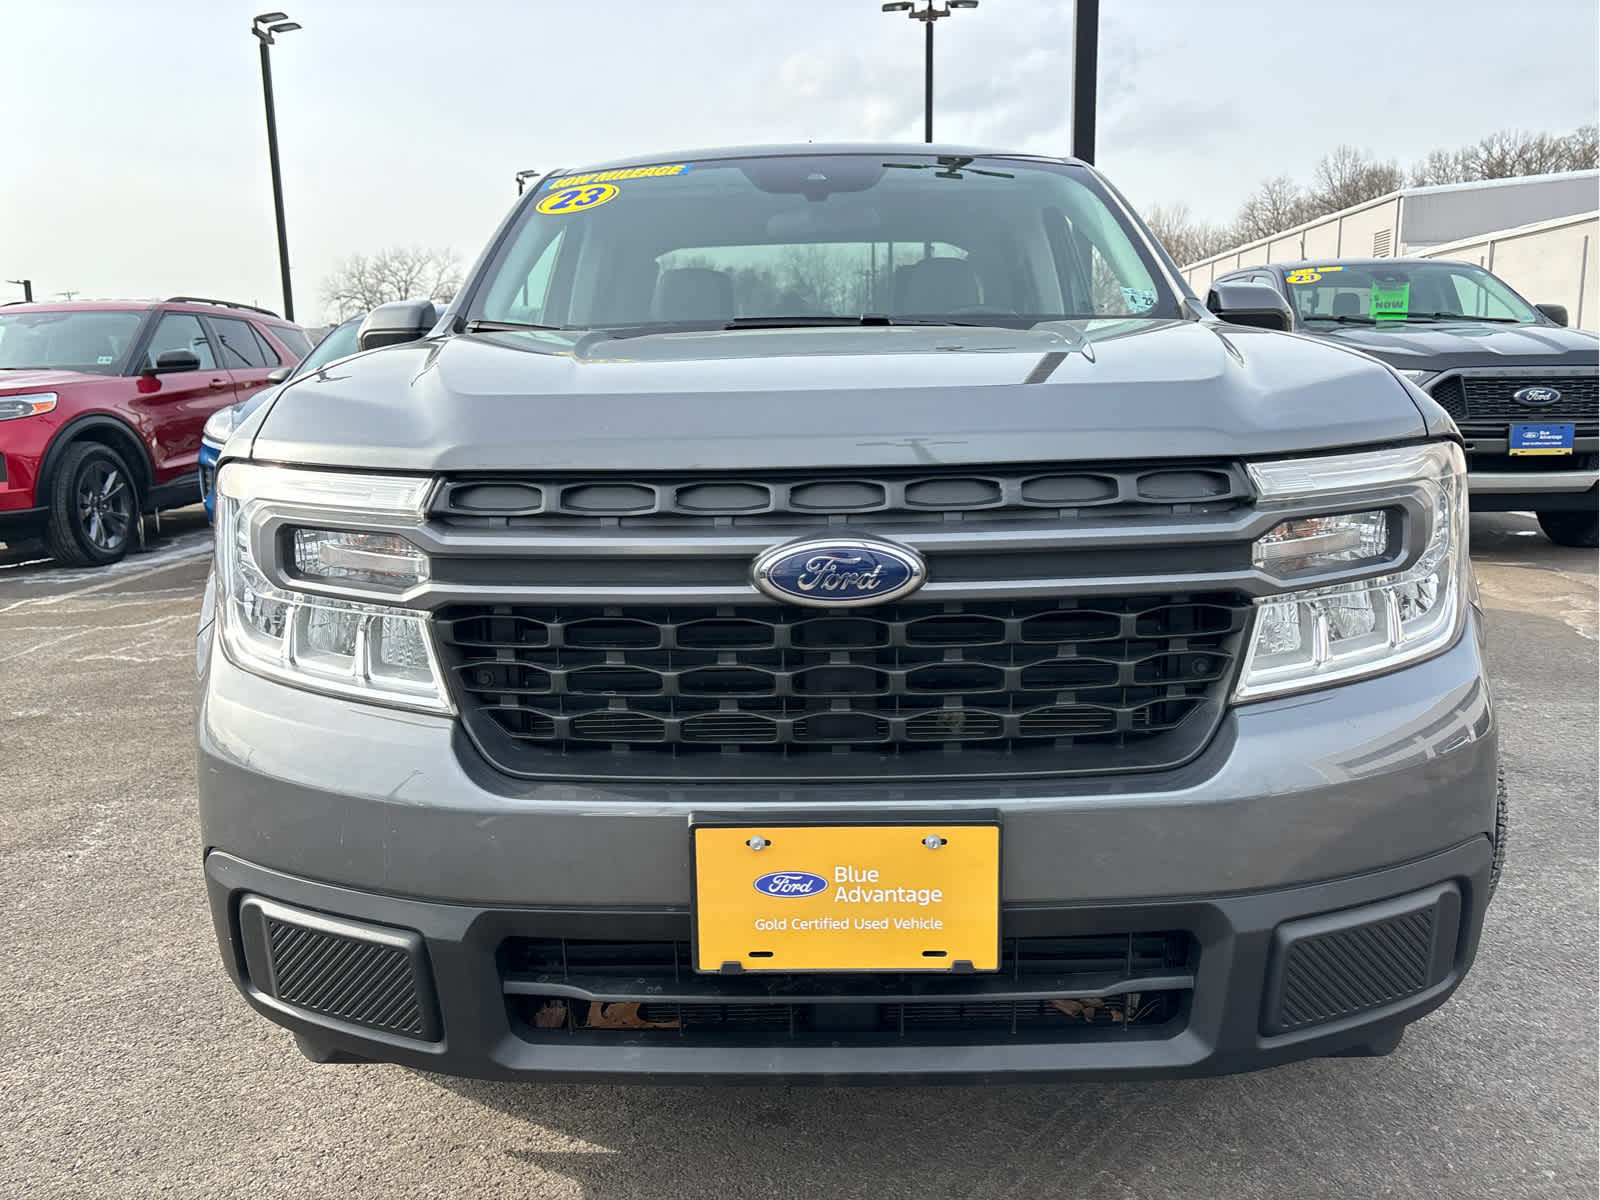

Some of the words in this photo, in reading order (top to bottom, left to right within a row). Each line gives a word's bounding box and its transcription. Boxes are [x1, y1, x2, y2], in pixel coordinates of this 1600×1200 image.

[549, 187, 606, 210] 23
[1376, 301, 1404, 309] NOW
[1526, 389, 1552, 401] Ford
[797, 555, 883, 591] Ford
[834, 866, 880, 883] Blue
[767, 875, 814, 894] Ford
[834, 886, 943, 906] Advantage
[755, 918, 787, 931] Gold
[791, 917, 850, 931] Certified
[854, 918, 889, 930] Used
[893, 917, 943, 930] Vehicle
